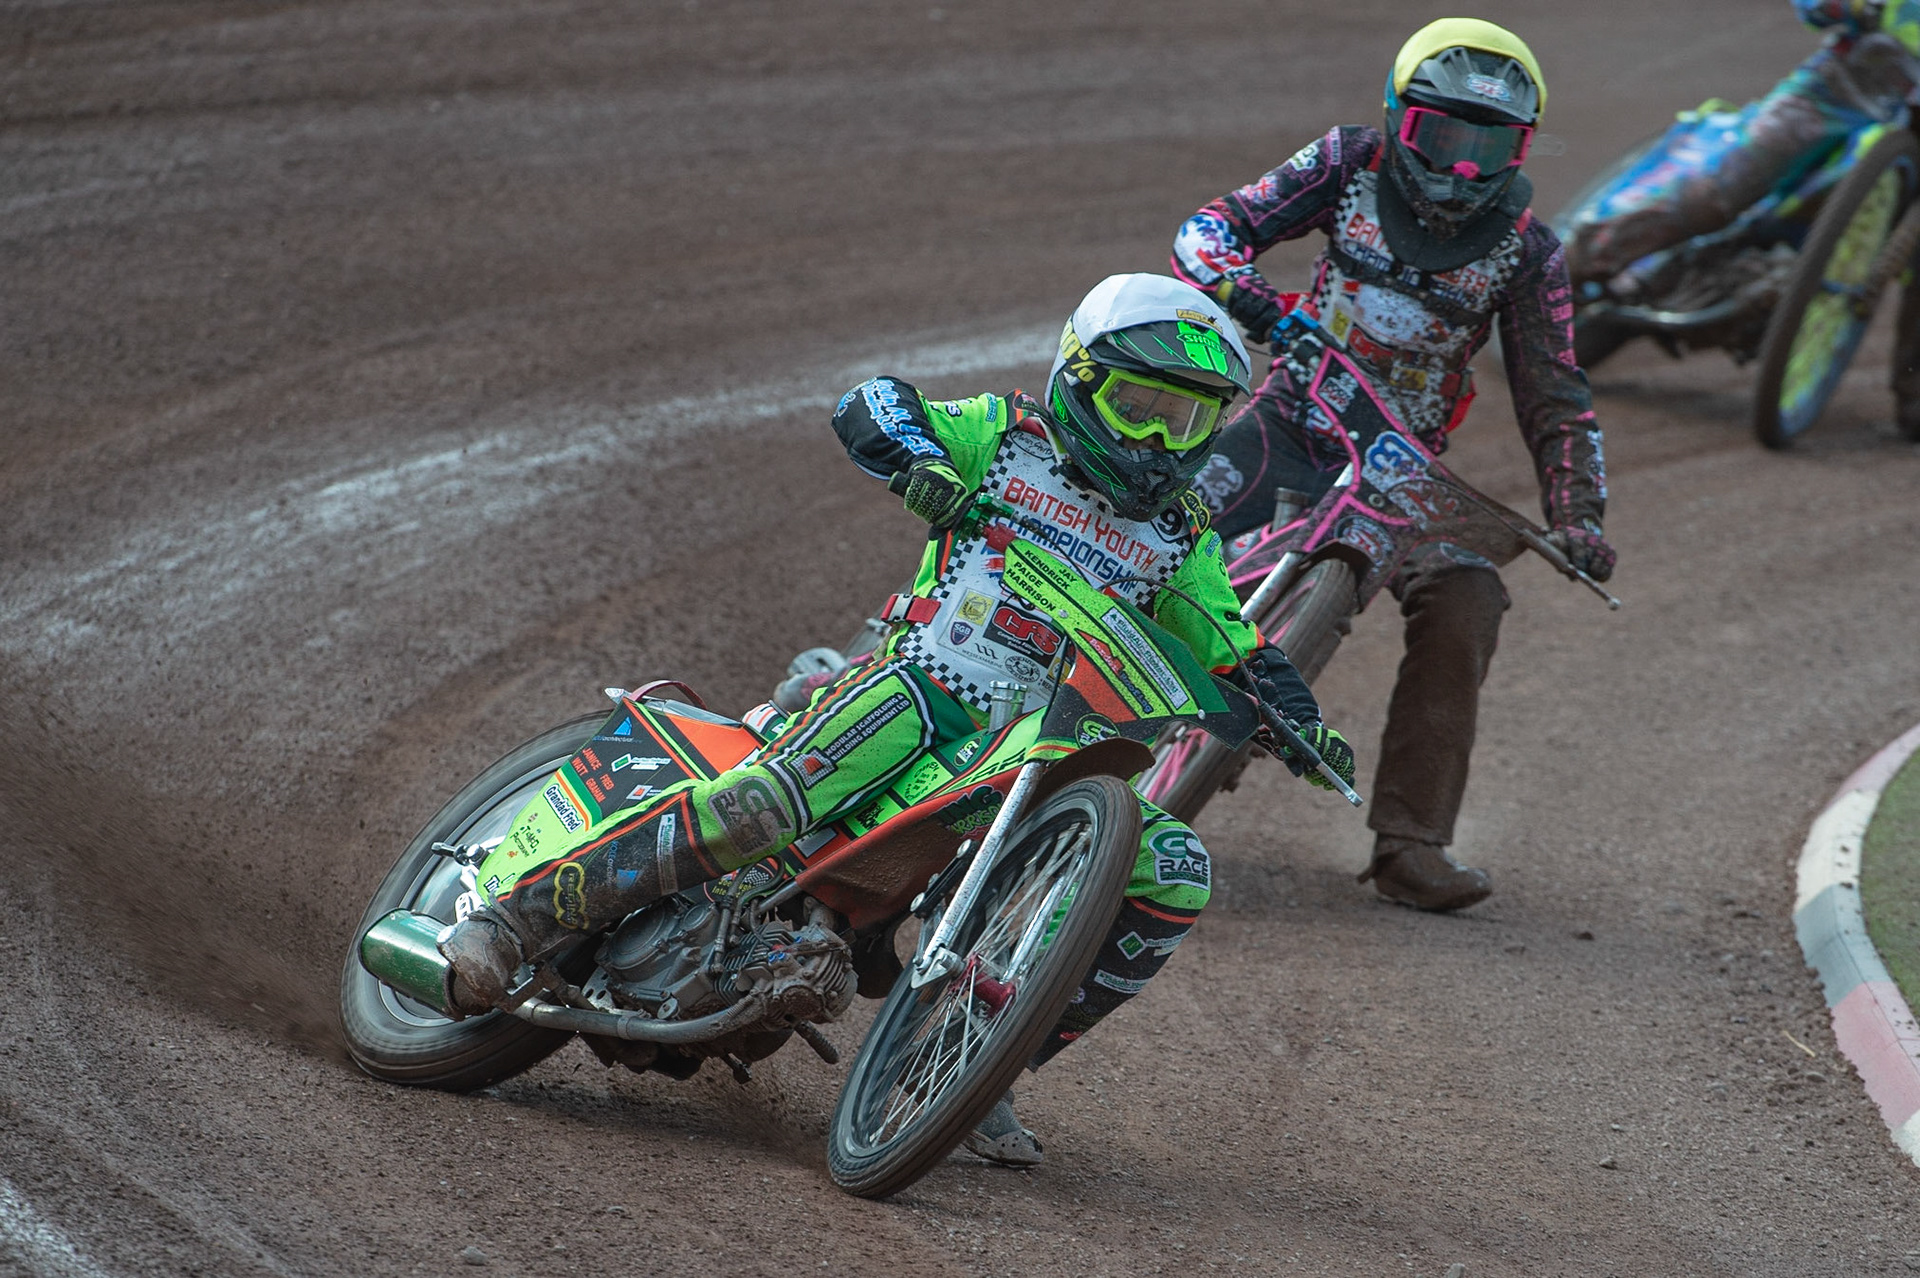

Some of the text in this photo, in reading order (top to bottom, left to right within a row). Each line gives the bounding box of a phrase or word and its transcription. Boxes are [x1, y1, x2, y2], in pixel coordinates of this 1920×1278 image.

[1003, 476, 1093, 534] BRITISH
[1093, 517, 1160, 574] YOUTH
[1157, 510, 1183, 536] 9
[1013, 562, 1043, 588] PAIGE
[1025, 550, 1071, 590] KENDRICK
[1058, 567, 1078, 583] JAY
[1005, 568, 1057, 612] HARRISON
[954, 623, 971, 635] SGB
[824, 728, 858, 757] MODULAR
[857, 697, 898, 730] SCAFFOLDING
[830, 699, 910, 761] BUILDING EQUIPMENT LTD
[571, 756, 589, 776] WATT
[581, 747, 602, 771] JANICE
[585, 777, 607, 803] GRAHAM
[599, 773, 615, 791] FRED
[545, 785, 582, 831] Grandad Fred
[1158, 858, 1209, 877] RACE
